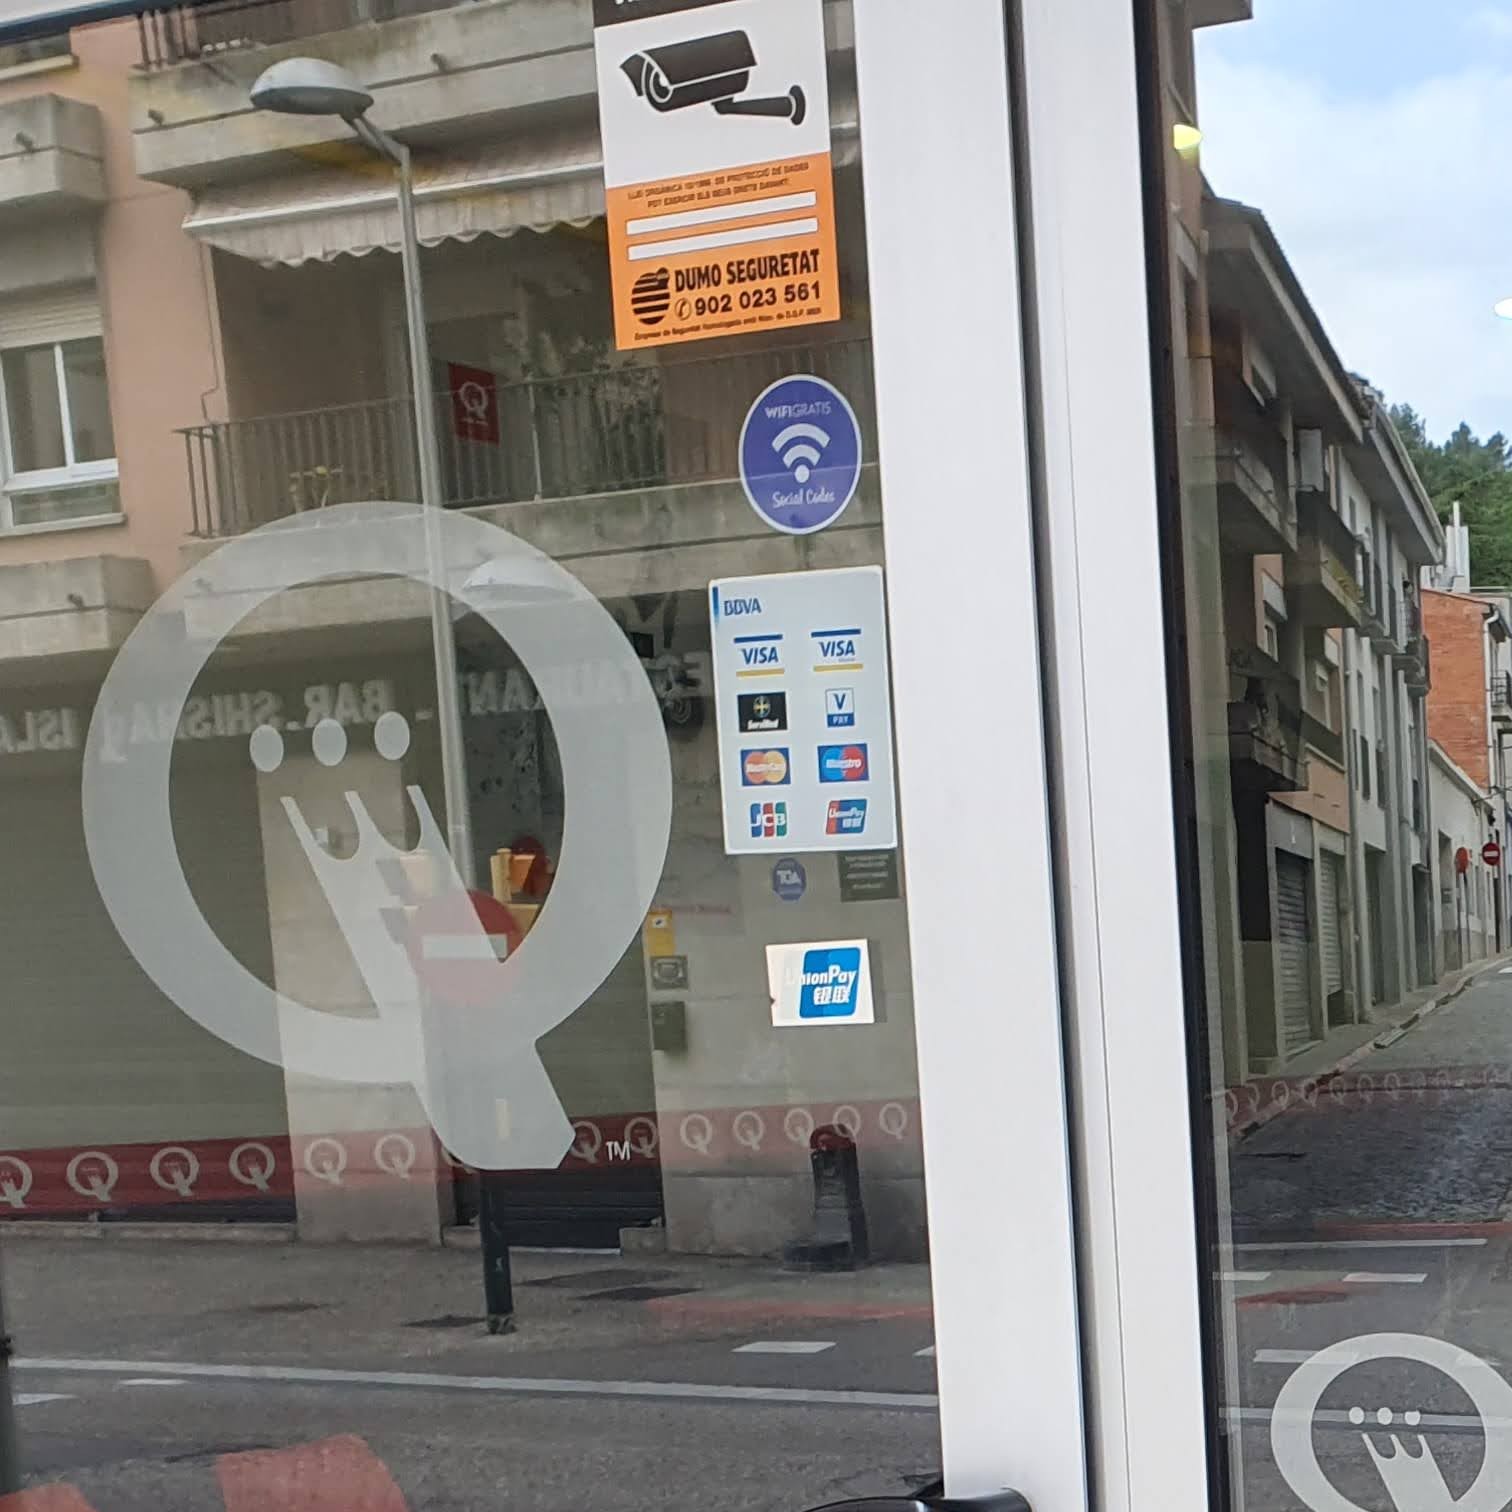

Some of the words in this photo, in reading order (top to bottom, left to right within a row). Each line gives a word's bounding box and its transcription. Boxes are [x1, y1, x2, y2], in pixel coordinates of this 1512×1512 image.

[674, 264, 721, 292] DUMO
[726, 248, 819, 285] SEGURETAT
[694, 294, 732, 316] 902
[739, 287, 777, 309] 023
[784, 280, 820, 303] 561
[772, 488, 803, 508] Social
[724, 598, 762, 616] BBVA
[741, 646, 778, 665] VISA
[819, 640, 855, 657] VISA
[833, 693, 846, 709] V
[833, 716, 848, 725] PAY
[750, 813, 786, 828] JCB
[606, 1141, 630, 1160] TM
